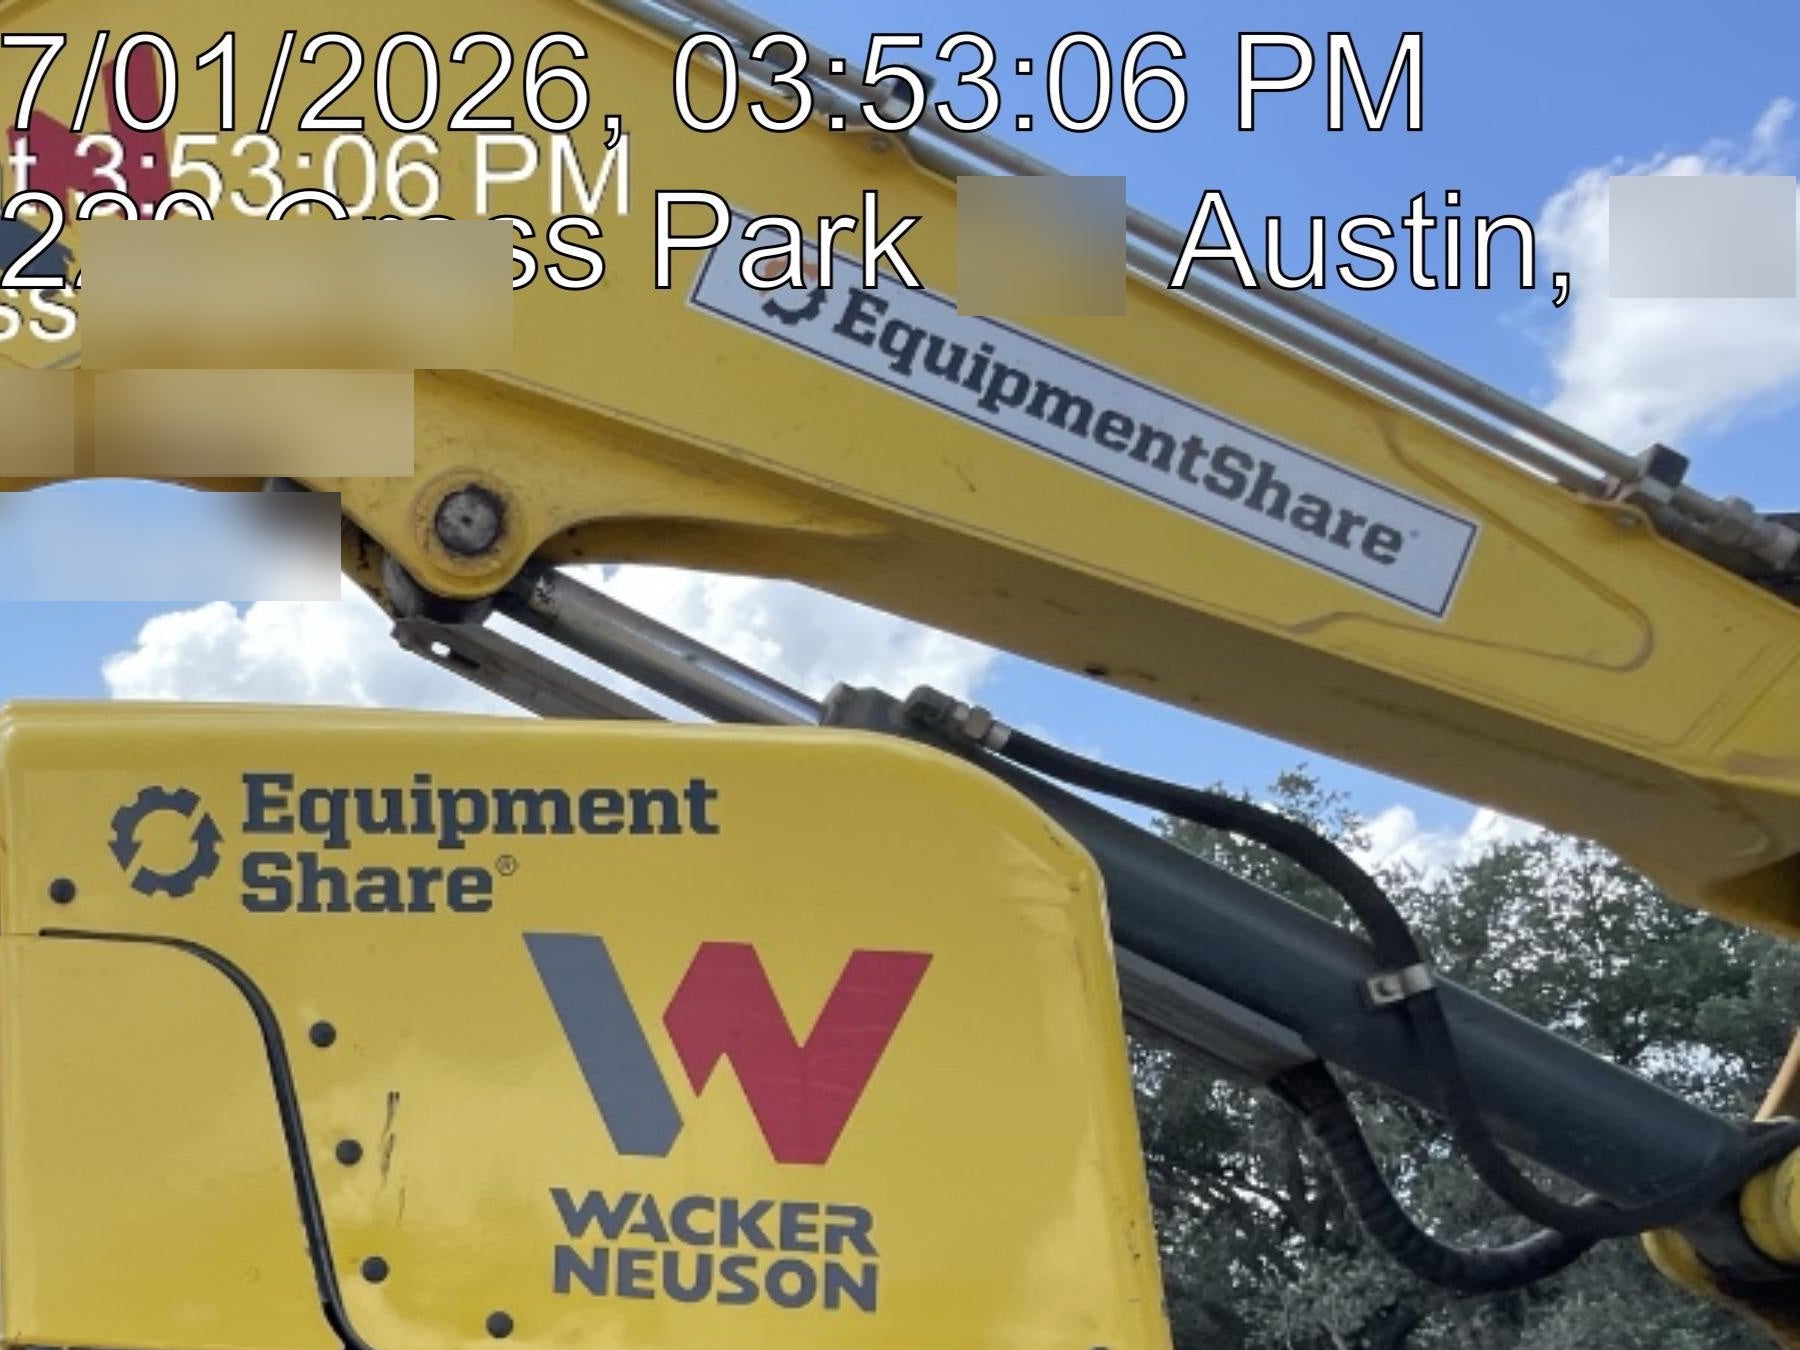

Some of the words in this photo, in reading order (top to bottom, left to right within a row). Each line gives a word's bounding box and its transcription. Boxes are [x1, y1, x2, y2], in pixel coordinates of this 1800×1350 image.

[832, 286, 1405, 567] EquipmentShare
[242, 774, 720, 849] Equipment
[549, 1187, 880, 1257] WACKER
[552, 1244, 878, 1313] NEUSON
